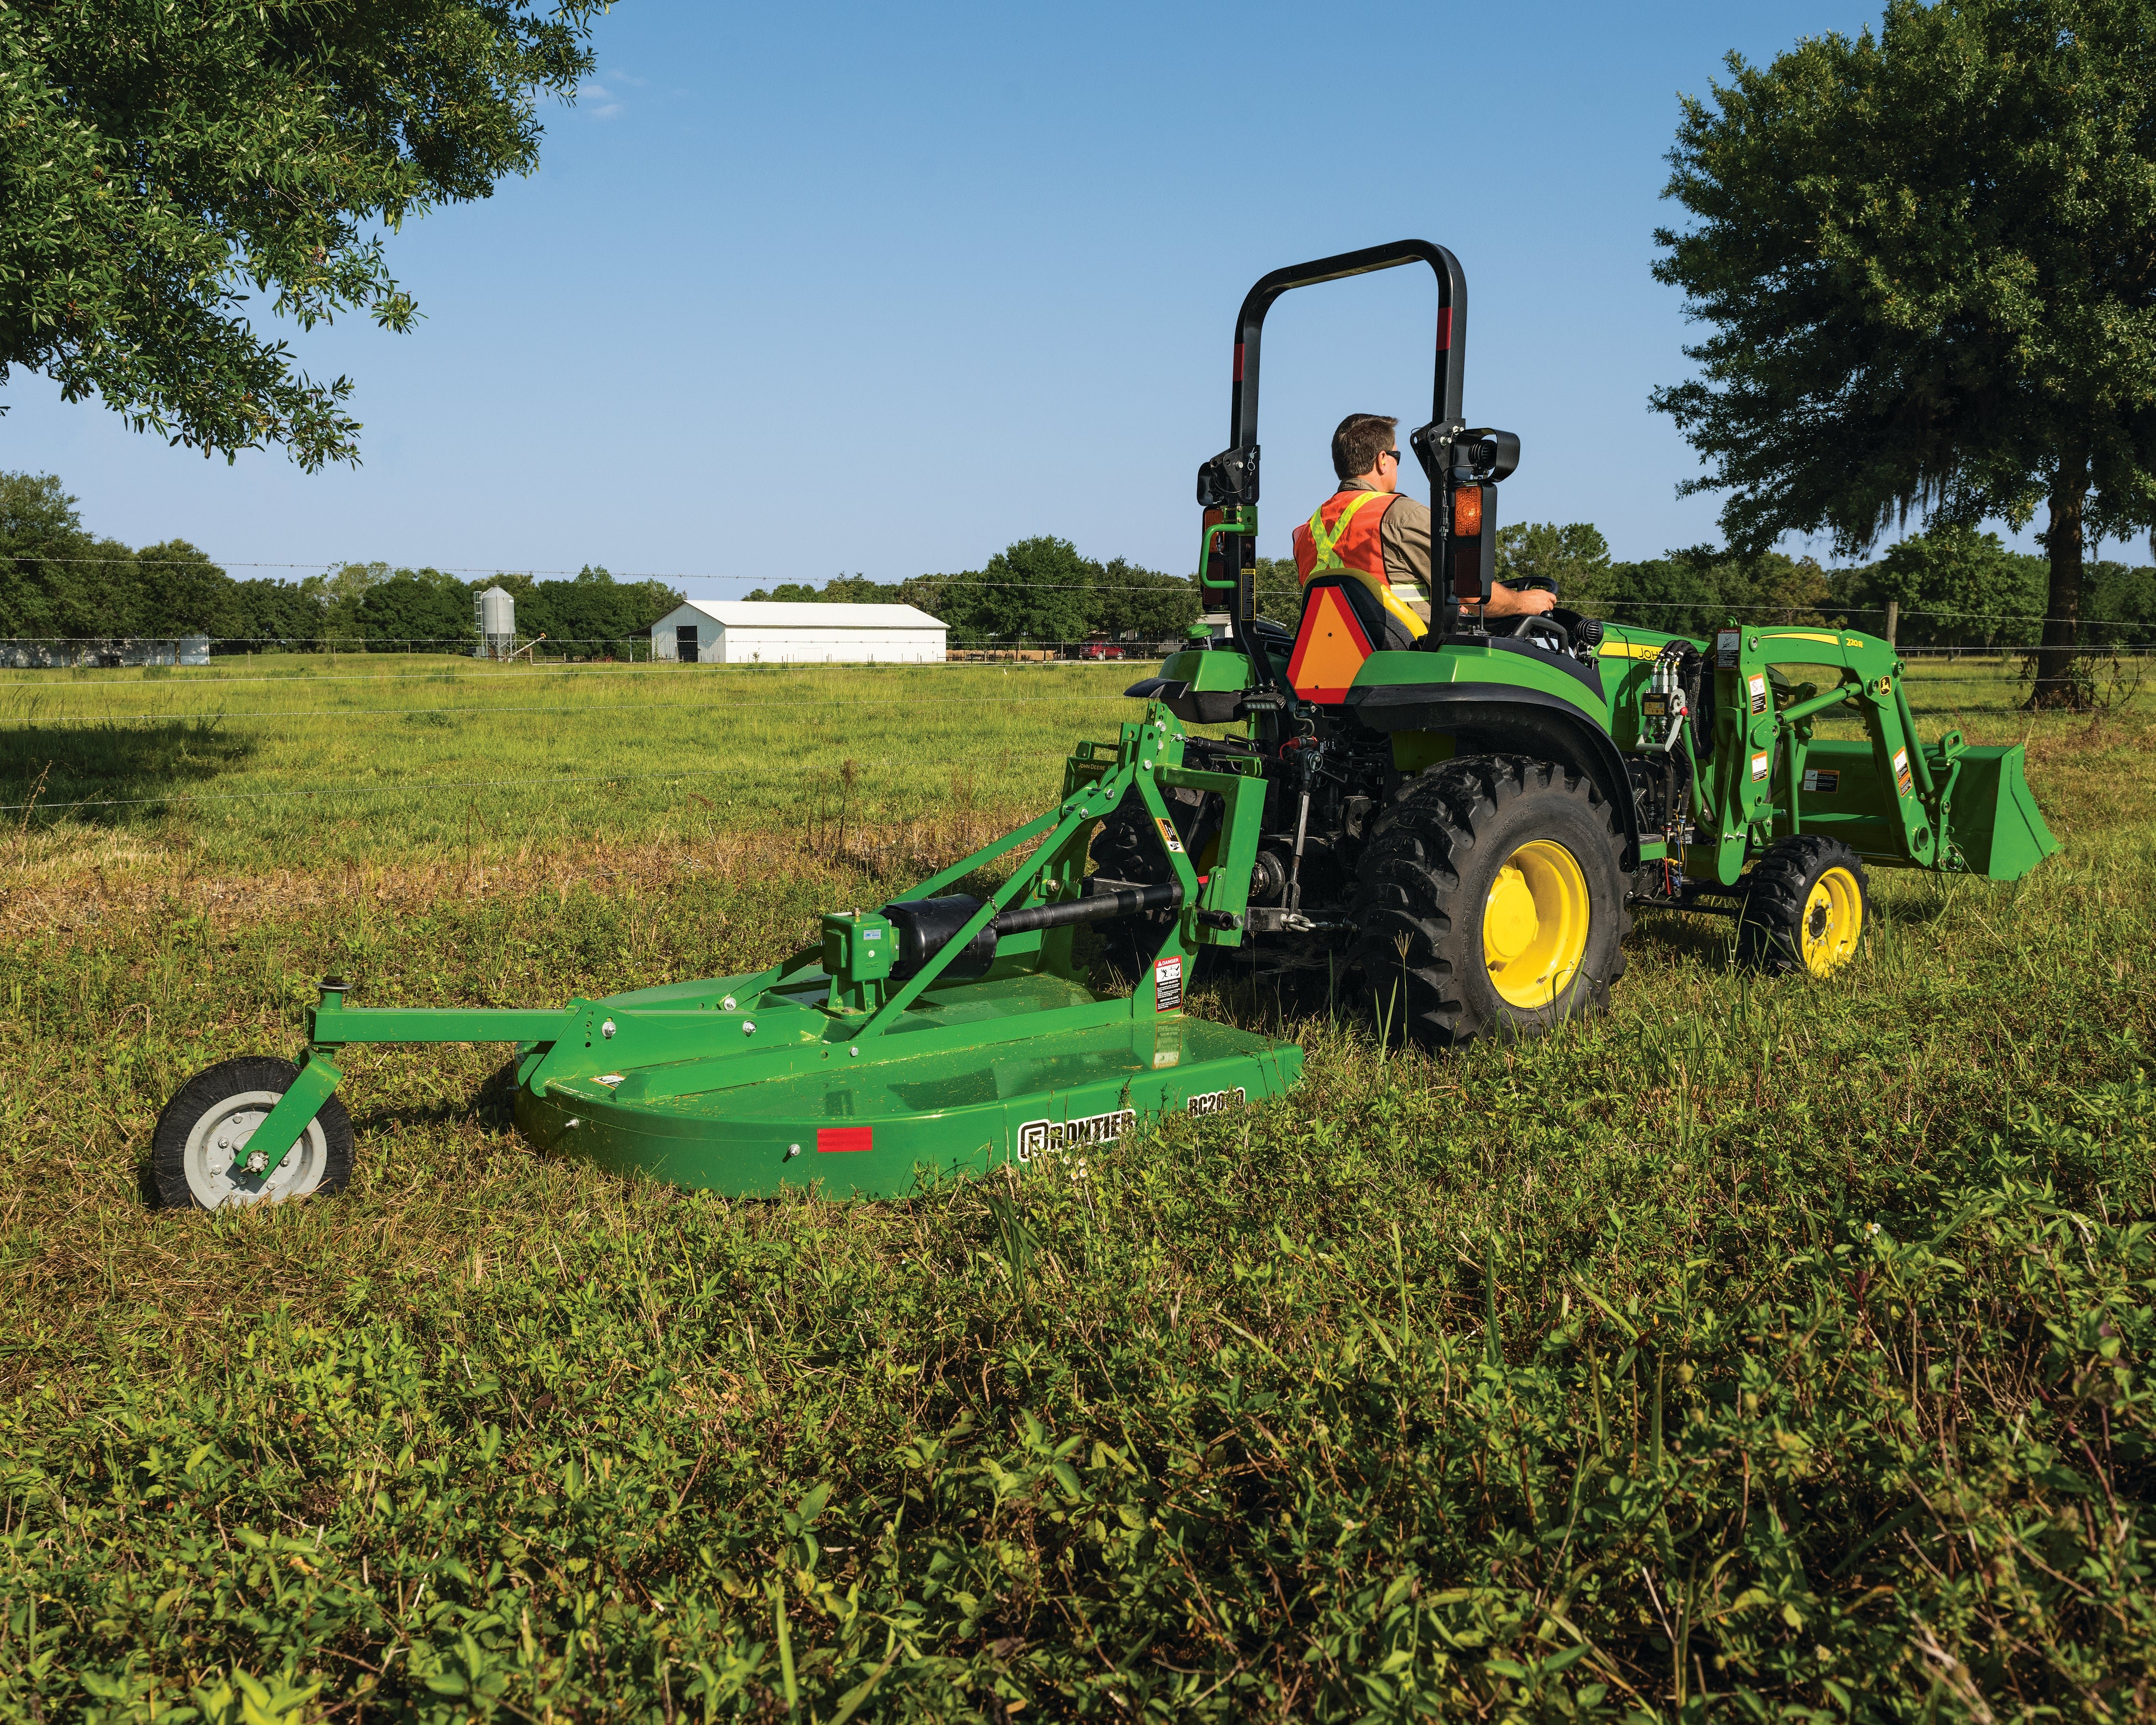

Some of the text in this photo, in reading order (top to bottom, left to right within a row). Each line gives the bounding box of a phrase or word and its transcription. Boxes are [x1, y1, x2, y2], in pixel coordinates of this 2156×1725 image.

[1846, 638, 1863, 648] 220R
[1639, 647, 1658, 659] JOH
[1189, 1089, 1244, 1117] RC200
